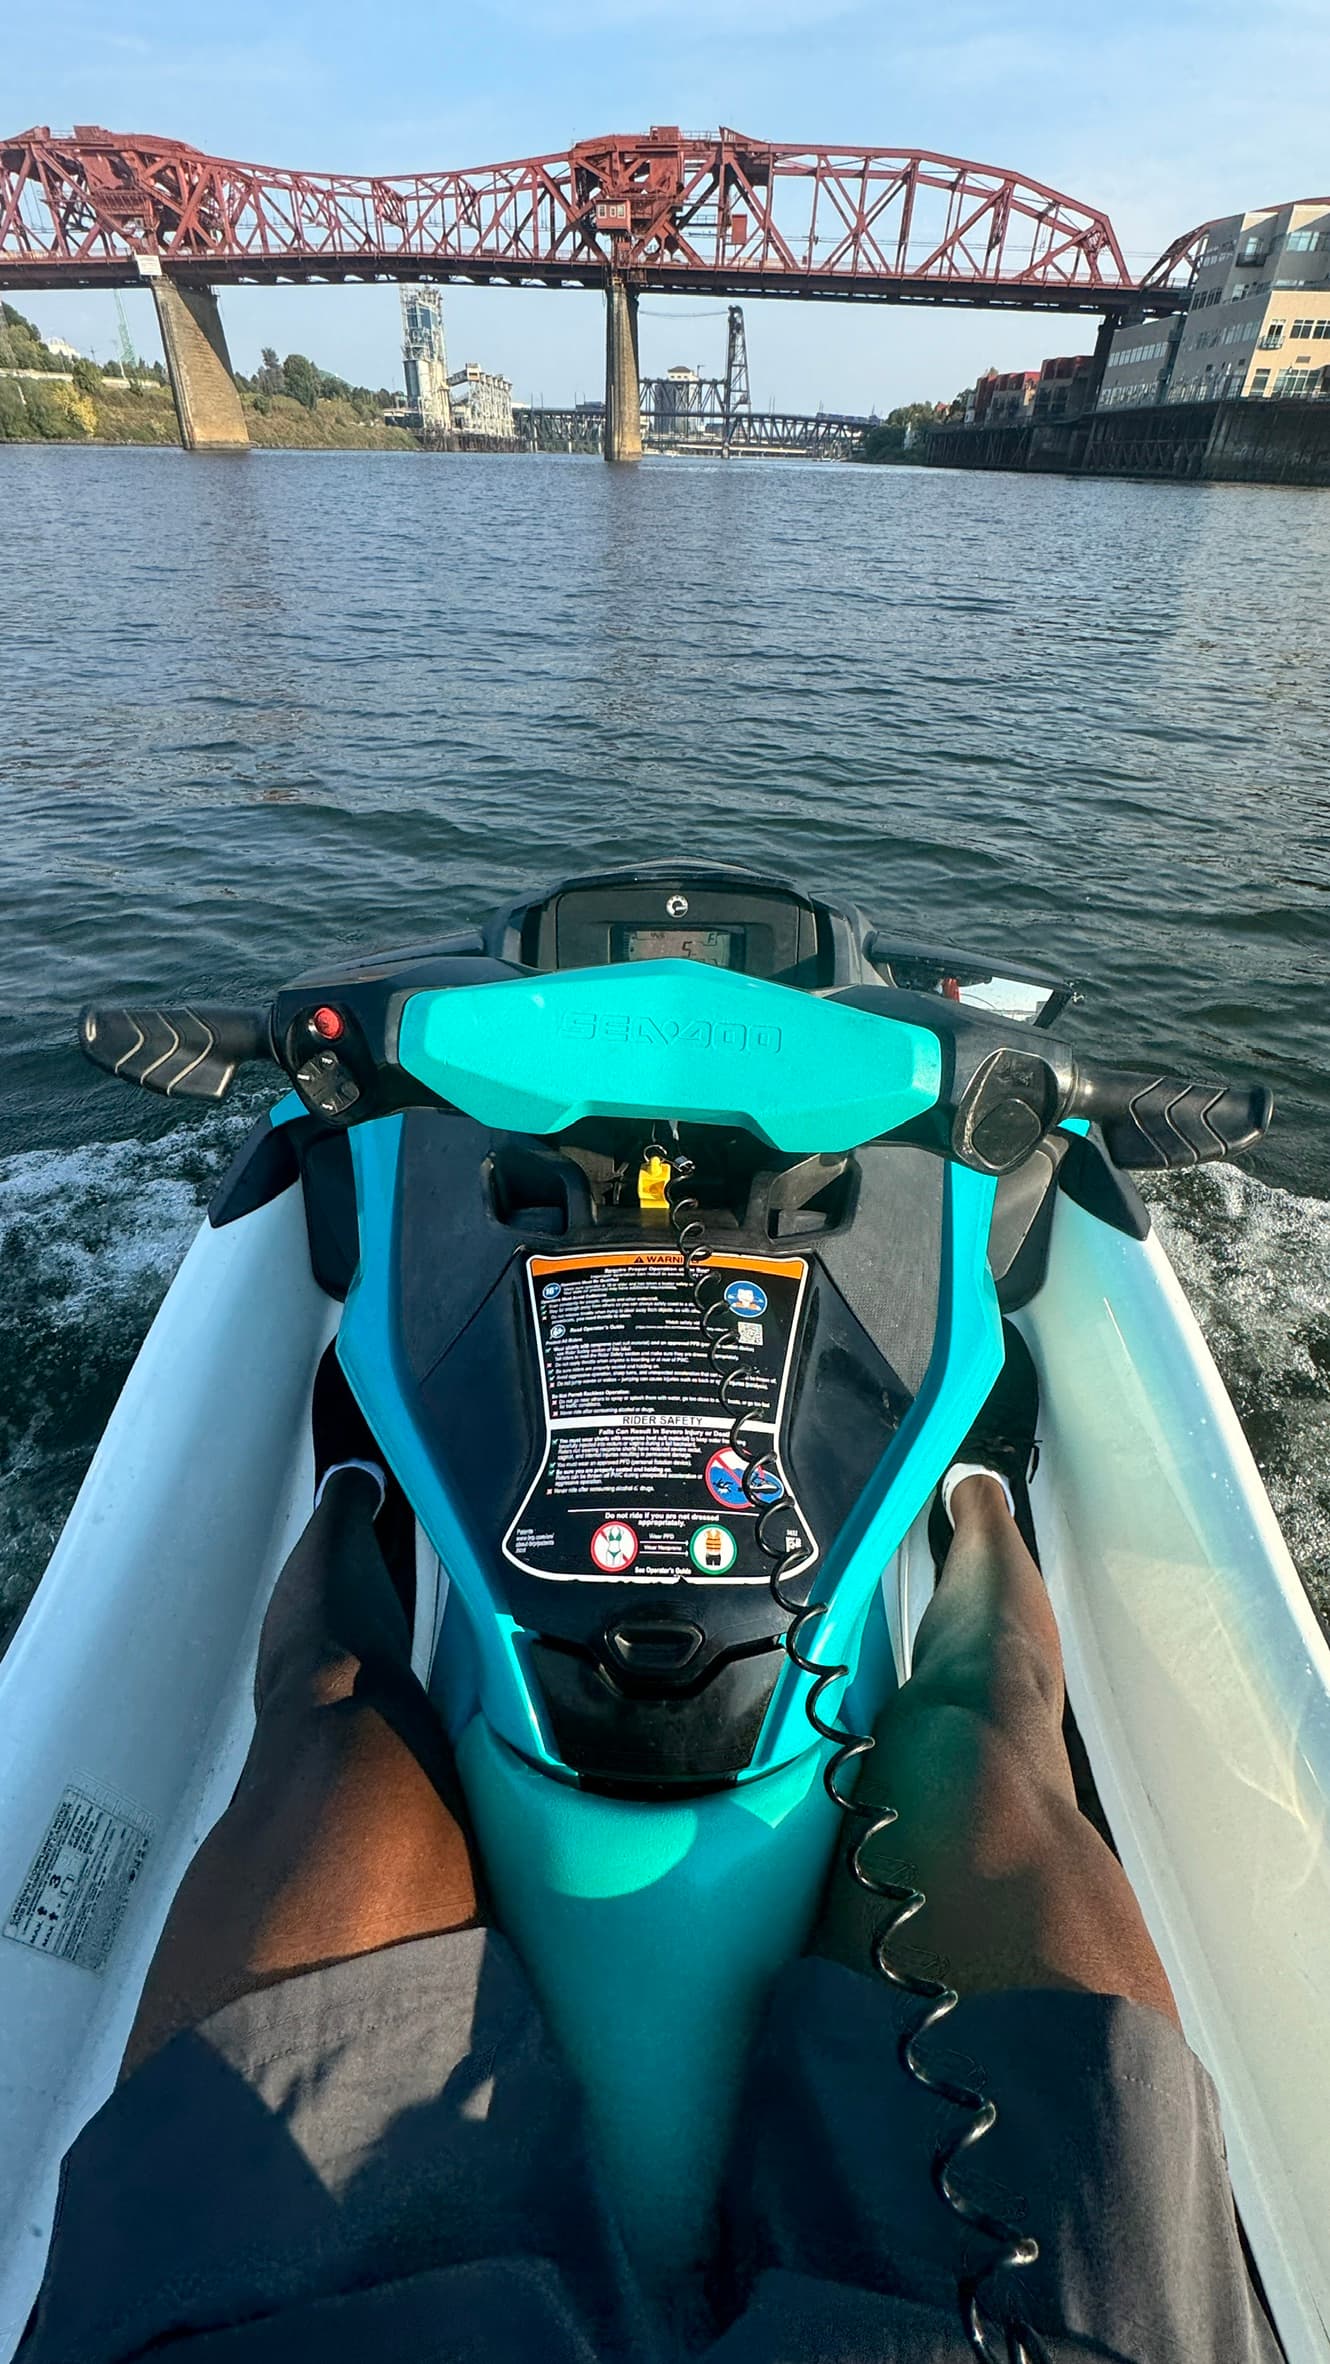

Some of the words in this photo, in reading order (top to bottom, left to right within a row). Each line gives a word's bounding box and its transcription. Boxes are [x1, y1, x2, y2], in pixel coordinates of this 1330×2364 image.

[646, 1256, 699, 1264] WARNI
[623, 1416, 656, 1424] RIDER
[660, 1416, 702, 1425] SAFETY
[47, 1872, 62, 1889] 3
